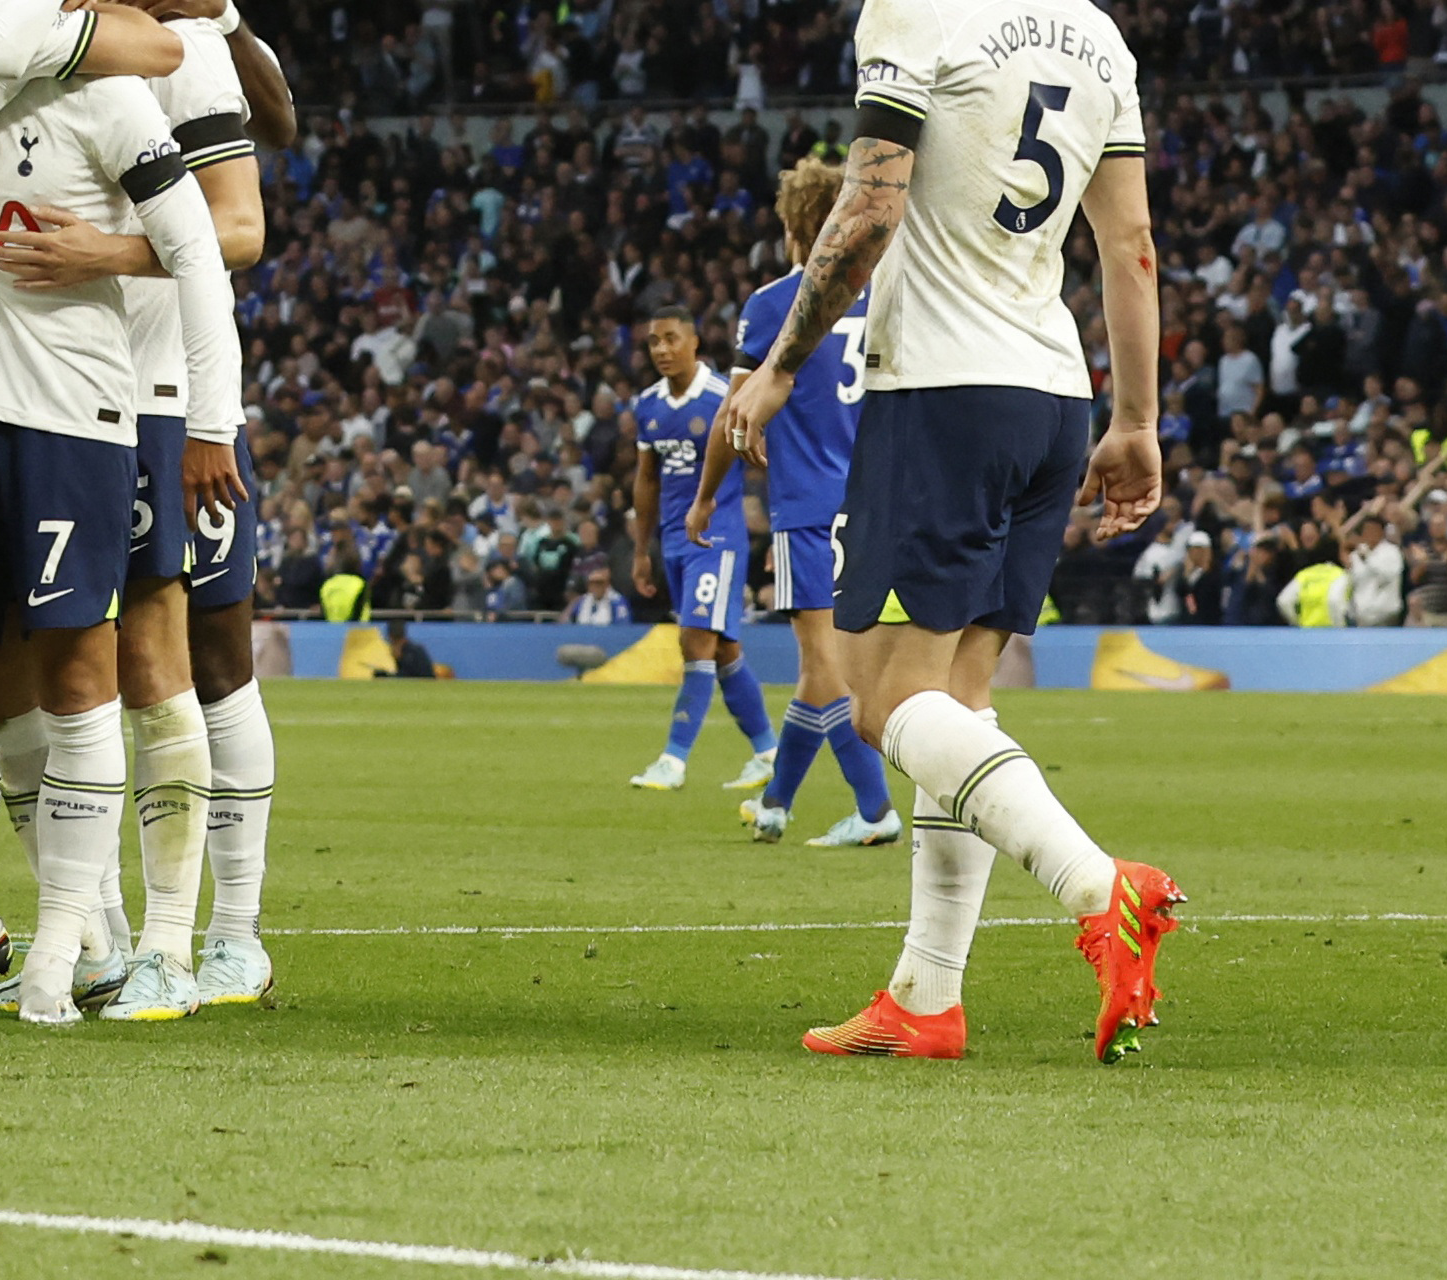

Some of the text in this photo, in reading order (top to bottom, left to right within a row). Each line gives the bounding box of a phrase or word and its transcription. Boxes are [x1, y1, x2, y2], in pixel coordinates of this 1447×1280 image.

[980, 16, 1112, 84] HØJBJERG
[992, 81, 1072, 234] 5
[832, 316, 866, 404] 3
[37, 519, 76, 584] 7
[191, 500, 236, 565] 9
[694, 572, 719, 605] 8
[45, 798, 109, 814] SPURS
[208, 811, 245, 823] URS
